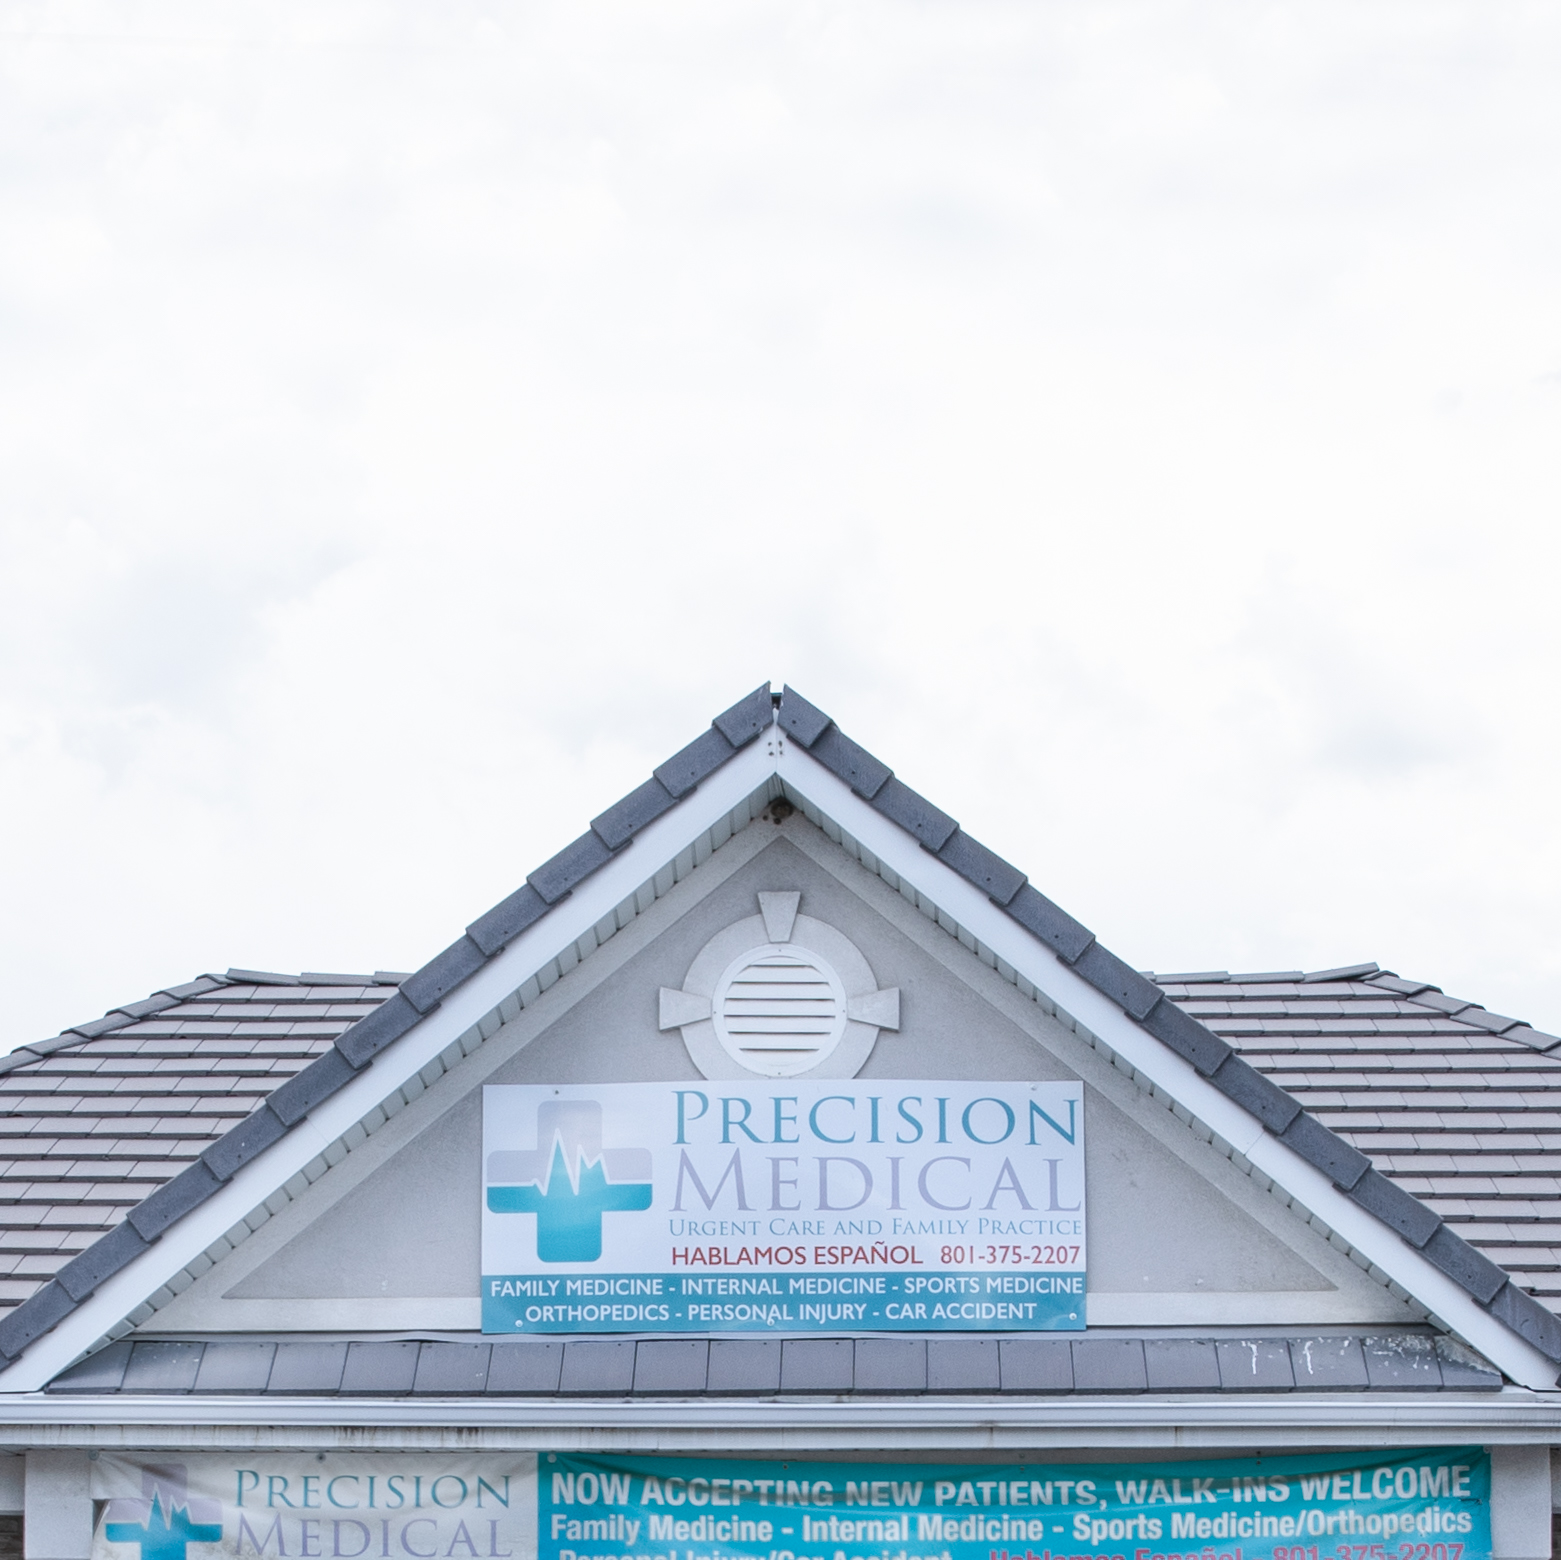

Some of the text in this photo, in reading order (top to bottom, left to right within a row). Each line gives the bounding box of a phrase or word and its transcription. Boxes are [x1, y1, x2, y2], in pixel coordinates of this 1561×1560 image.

[671, 1090, 1079, 1146] PRECISION
[669, 1147, 1081, 1212] MEDICAL
[669, 1218, 1082, 1236] URGENT CARE AND FAMILY PRACTICE
[672, 1241, 1080, 1266] HABLAMOS ESPAÑOL 801-375-2207
[491, 1280, 560, 1297] FAMILY
[566, 1279, 663, 1296] MEDICINE
[682, 1278, 783, 1295] INTERNAL
[789, 1278, 886, 1295] MEDICINE
[904, 1277, 980, 1294] SPORTS
[986, 1277, 1083, 1294] MEDICINE
[525, 1304, 669, 1323] ORTHOPEDICS
[688, 1304, 793, 1321] PERSONAL
[799, 1303, 867, 1324] INJURY
[885, 1303, 927, 1319] CAR
[932, 1302, 1037, 1320] ACCIDENT
[234, 1469, 511, 1509] PRECISION
[552, 1465, 1471, 1511] NOW ACCEPTING NEW PATIENTS, WALK-INS WELCOME
[235, 1511, 513, 1558] MEDICAL
[551, 1514, 640, 1546] Family
[648, 1514, 773, 1541] Medicine
[802, 1514, 909, 1542] Internal
[918, 1514, 1043, 1541] Medicine
[1072, 1513, 1162, 1546] Sports
[1171, 1506, 1472, 1540] Medicine/Orthopedics
